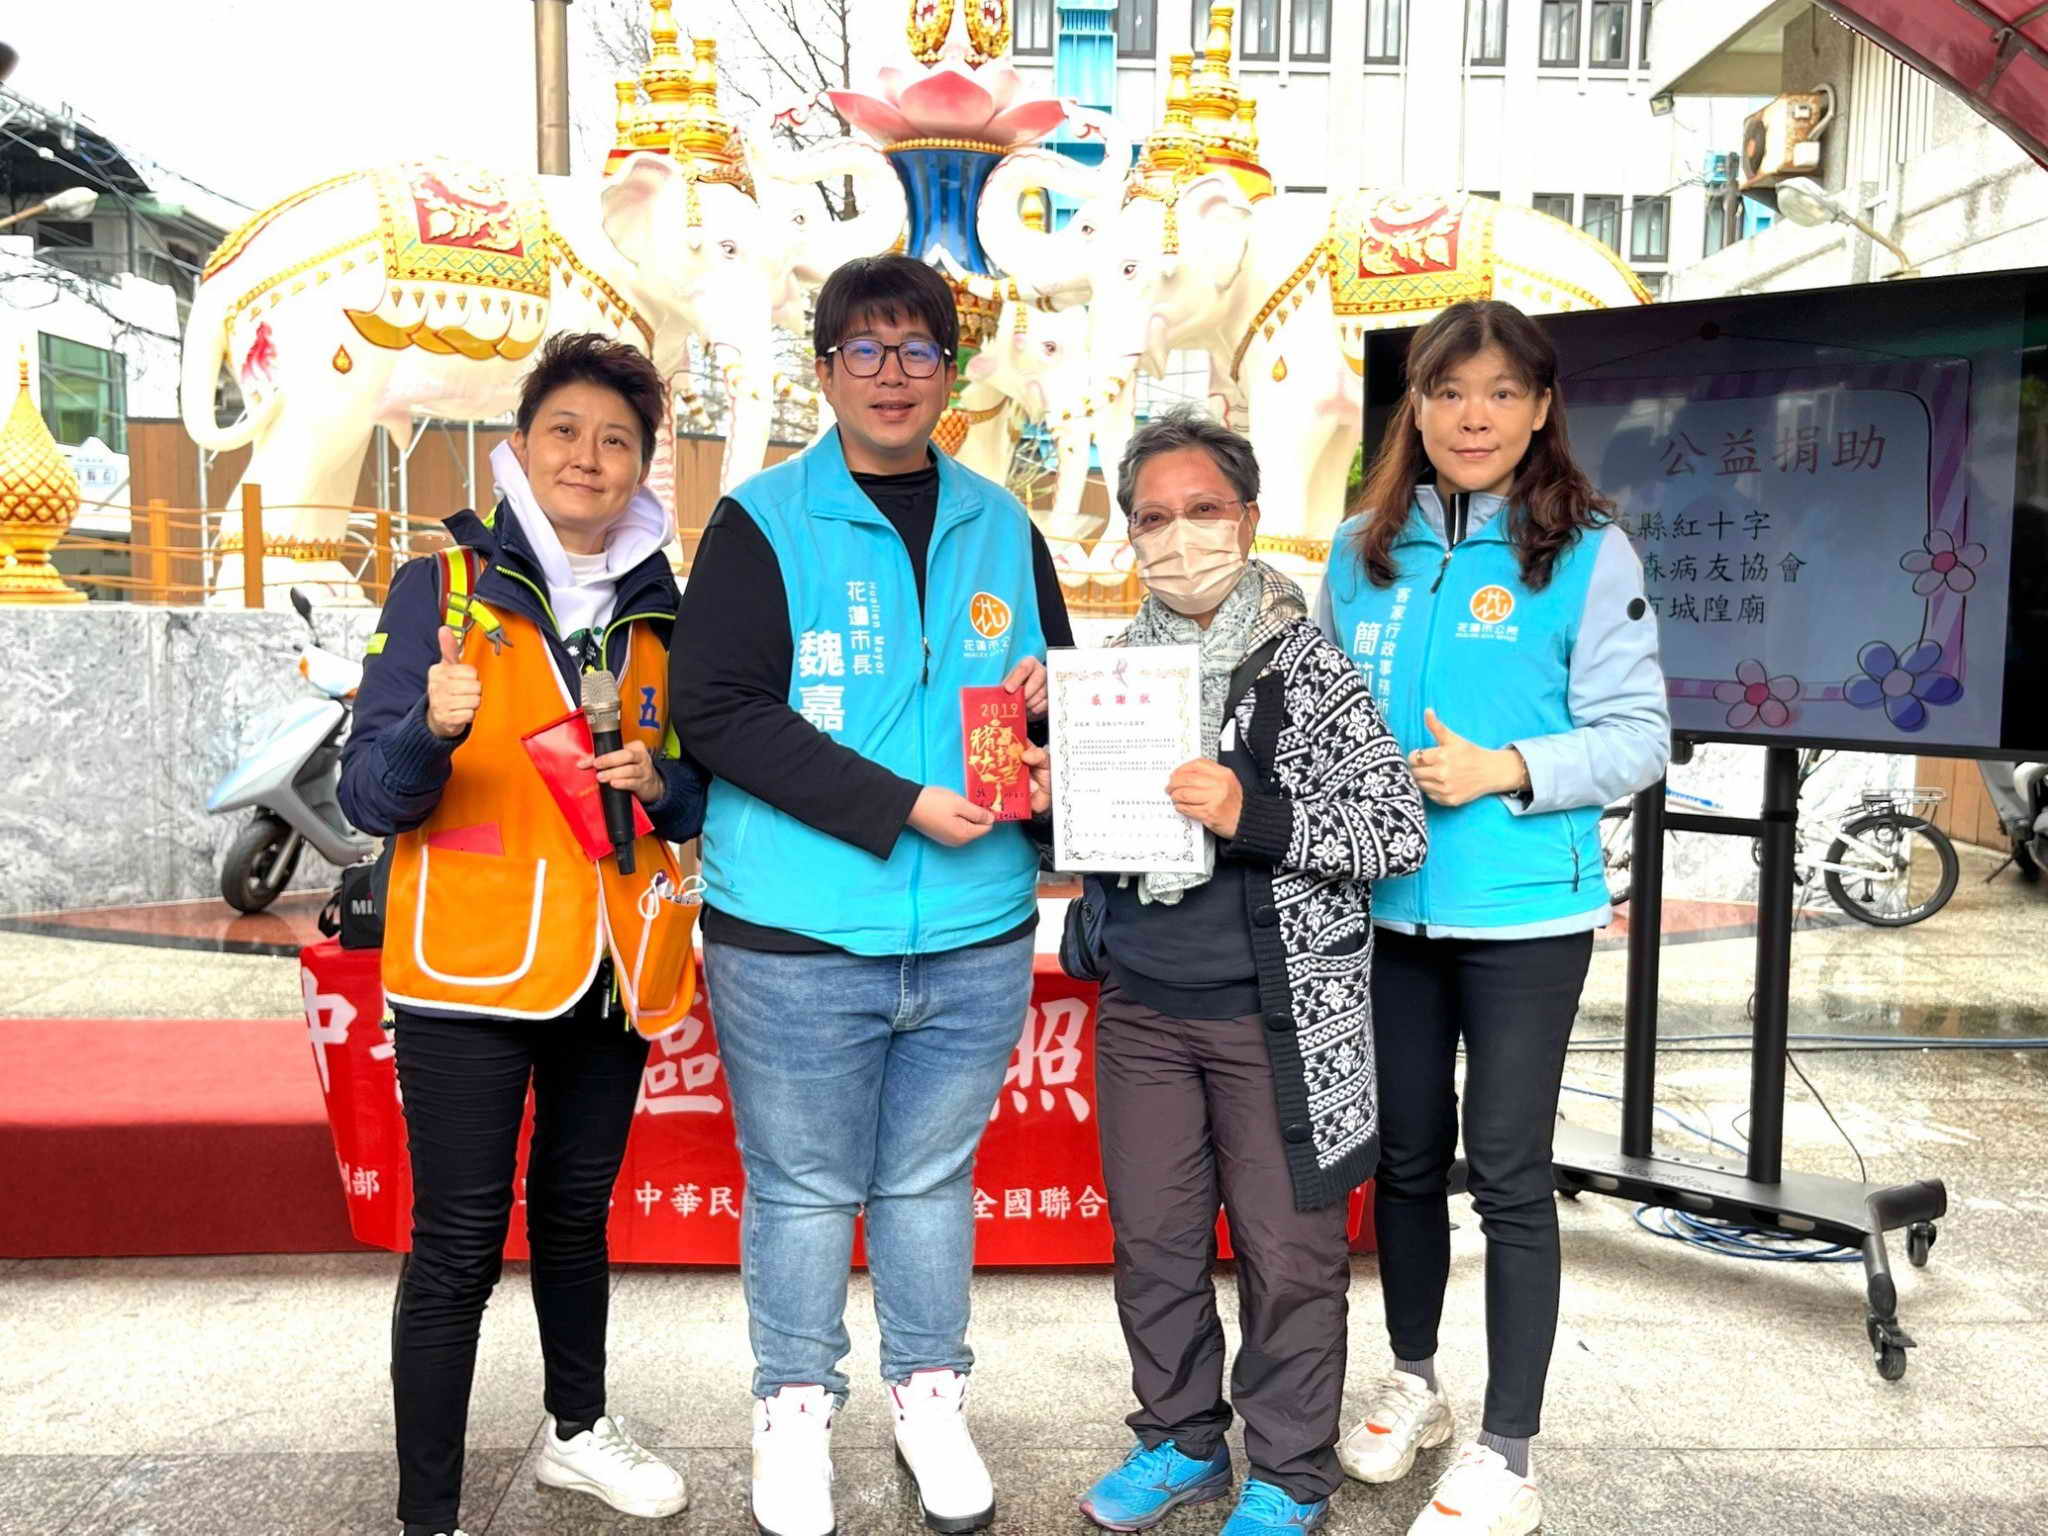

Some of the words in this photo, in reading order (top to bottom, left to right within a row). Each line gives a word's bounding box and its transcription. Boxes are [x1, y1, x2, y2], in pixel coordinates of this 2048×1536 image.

[1660, 423, 1887, 477] 公益捐助
[847, 580, 873, 676] 花蓮市長
[980, 703, 1019, 718] 2019
[351, 899, 377, 915] MI
[635, 1181, 740, 1220] 中華民
[973, 1185, 1109, 1220] 全國聯合
